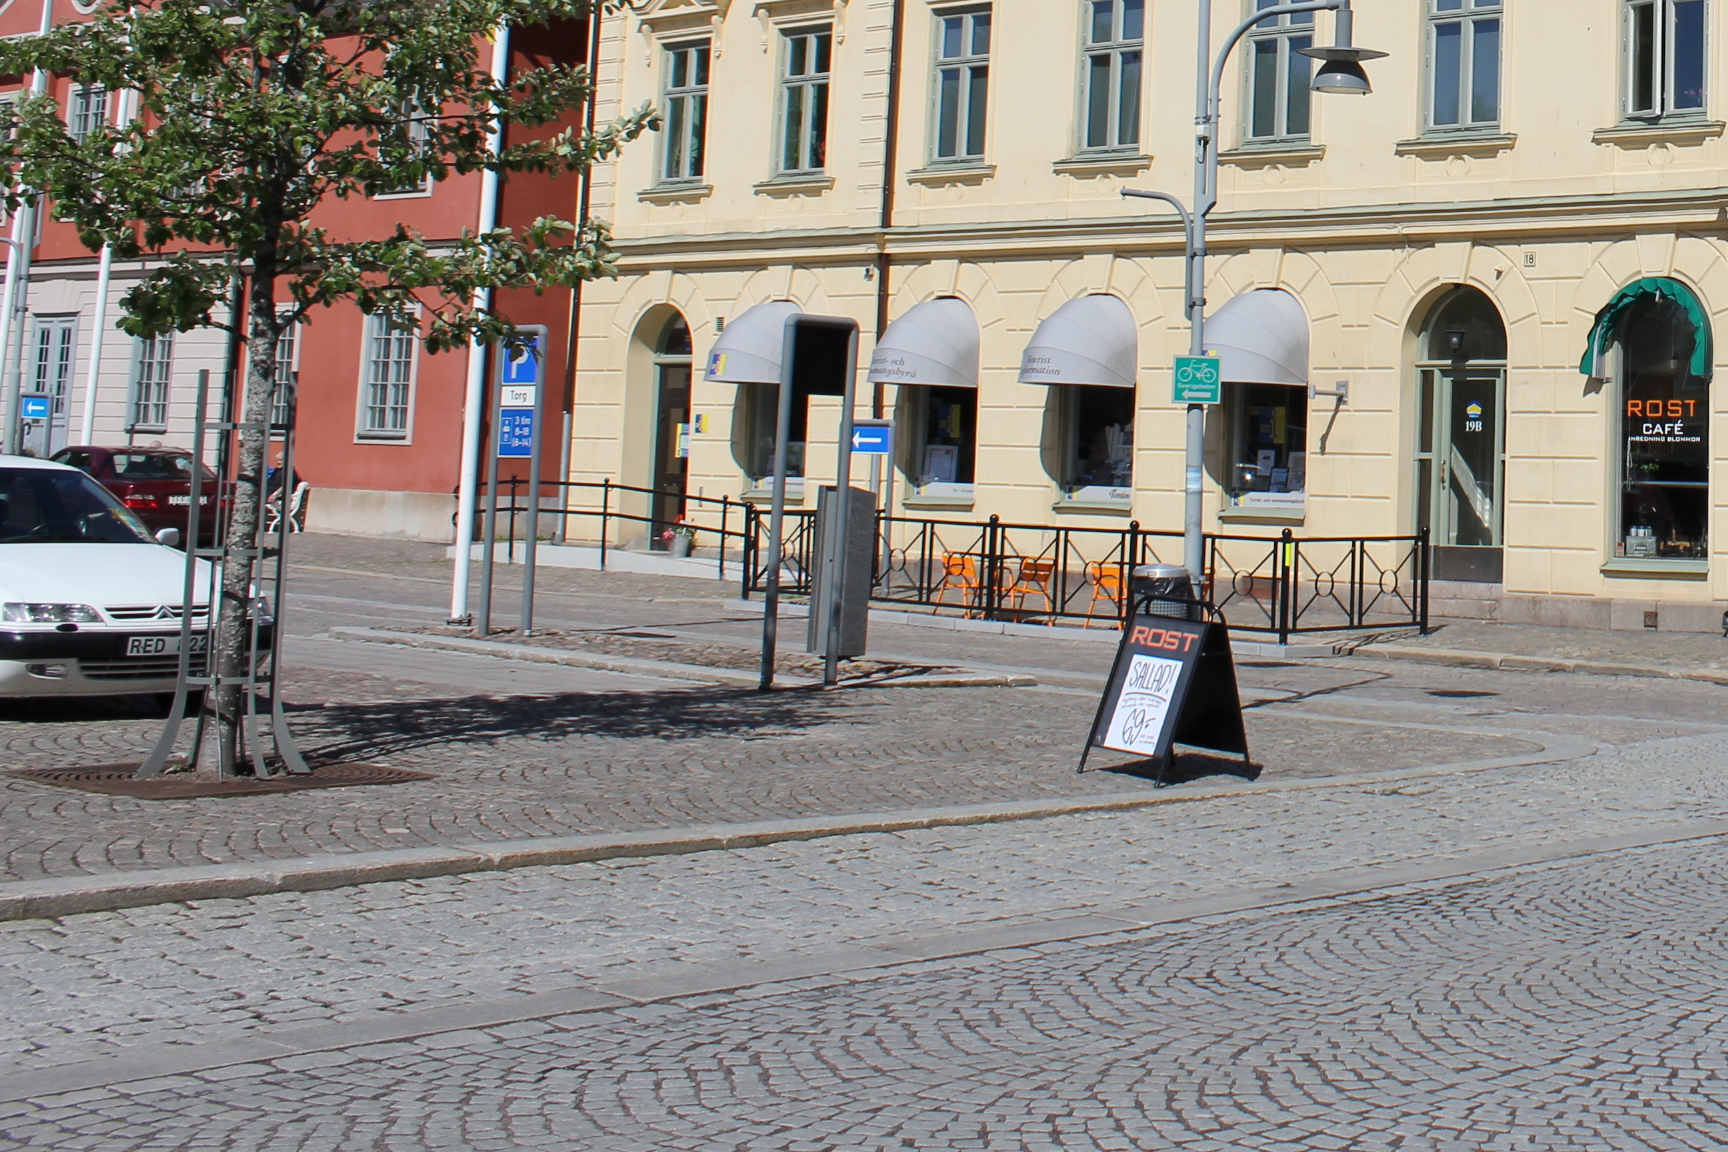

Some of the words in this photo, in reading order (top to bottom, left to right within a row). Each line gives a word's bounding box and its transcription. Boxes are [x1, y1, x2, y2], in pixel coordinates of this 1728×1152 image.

[1525, 253, 1534, 264] 18
[510, 390, 527, 403] Torg
[1627, 400, 1697, 417] ROST
[514, 416, 520, 425] 3
[1465, 420, 1483, 432] 19B
[1642, 419, 1684, 435] CAFÉ
[129, 637, 166, 654] RED
[177, 636, 207, 652] 22
[1130, 625, 1199, 652] ROST
[1128, 661, 1178, 695] SALLAD!
